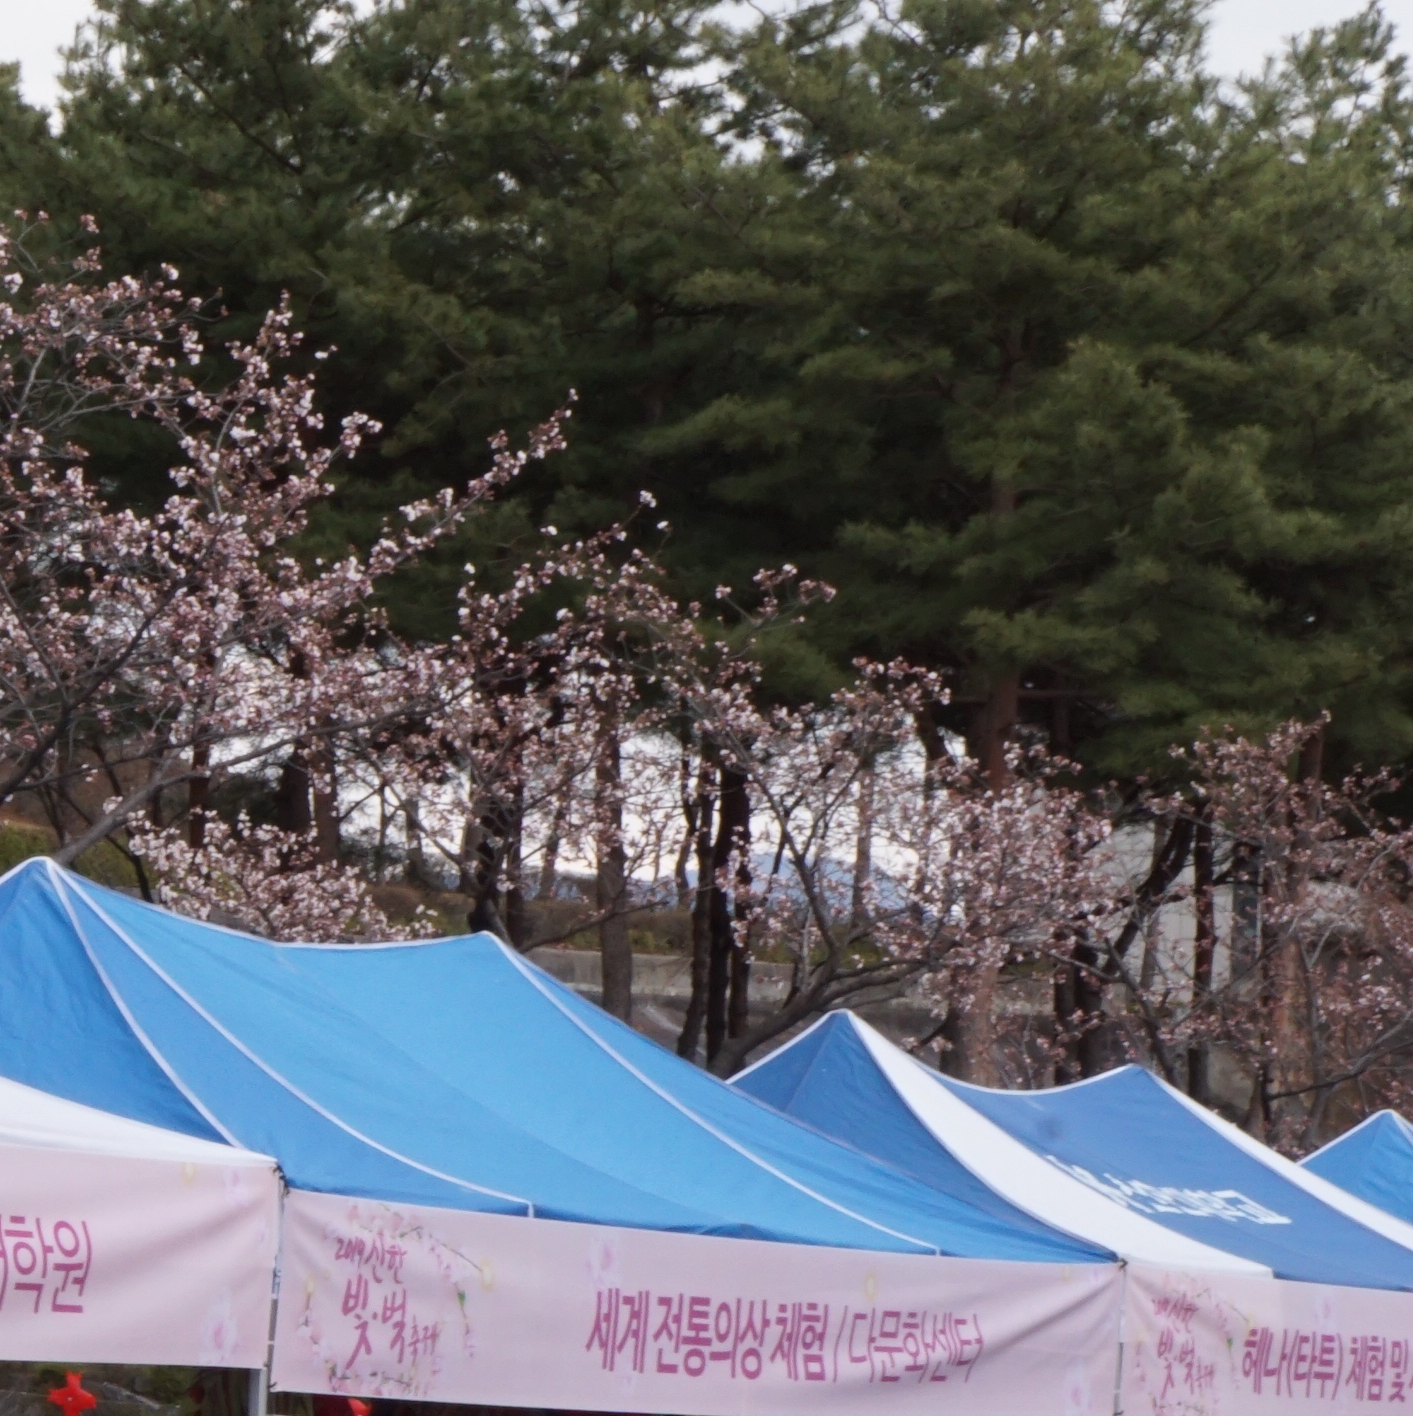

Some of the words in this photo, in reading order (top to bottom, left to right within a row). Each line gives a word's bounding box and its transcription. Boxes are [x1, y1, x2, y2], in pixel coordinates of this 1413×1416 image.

[585, 1287, 650, 1374] 세계
[652, 1292, 771, 1379] 전통의상
[770, 1302, 830, 1382] 체험
[848, 1307, 985, 1384] 다문화센터
[1241, 1327, 1343, 1400] 헤나(타투)
[1345, 1335, 1387, 1401] 체험
[1388, 1338, 1410, 1403] 및
